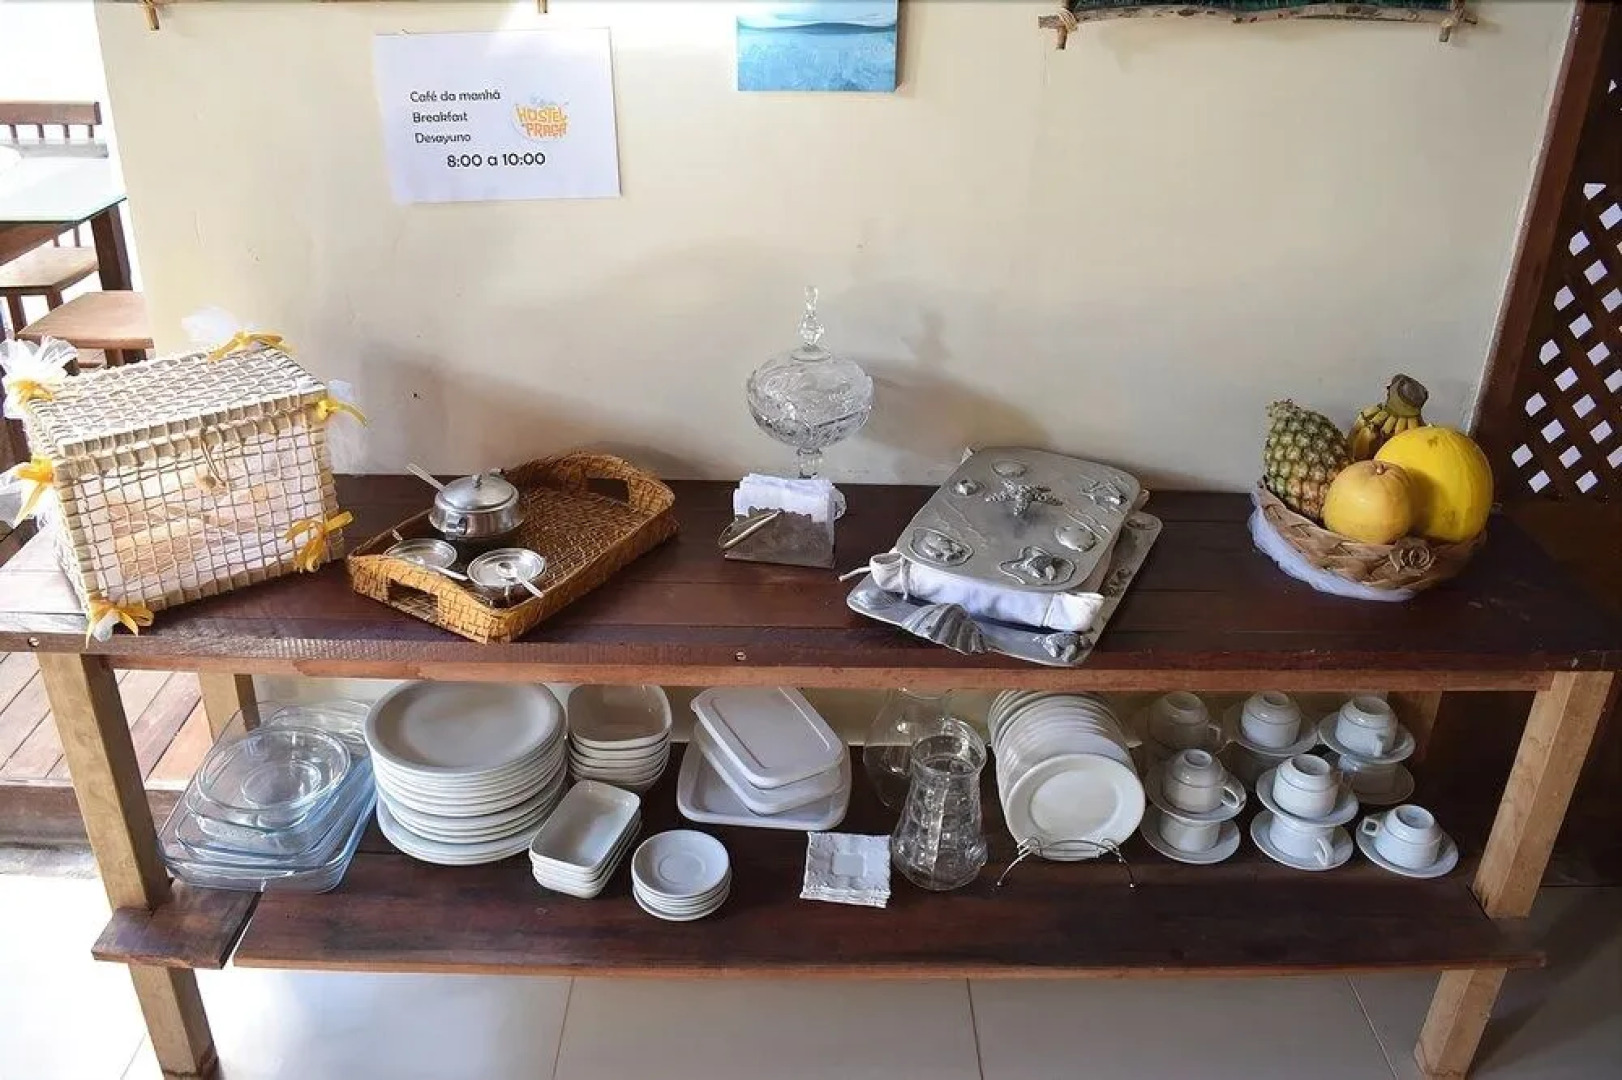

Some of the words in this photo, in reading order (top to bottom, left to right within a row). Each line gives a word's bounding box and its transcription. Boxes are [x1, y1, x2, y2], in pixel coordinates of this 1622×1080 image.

[410, 90, 437, 103] Café
[440, 91, 456, 102] da
[413, 111, 468, 123] Breakfast
[516, 106, 568, 124] HOSTEL
[415, 132, 471, 144] Desayuno
[447, 154, 482, 168] 8:00
[487, 155, 498, 167] a
[502, 152, 546, 166] 10:00
